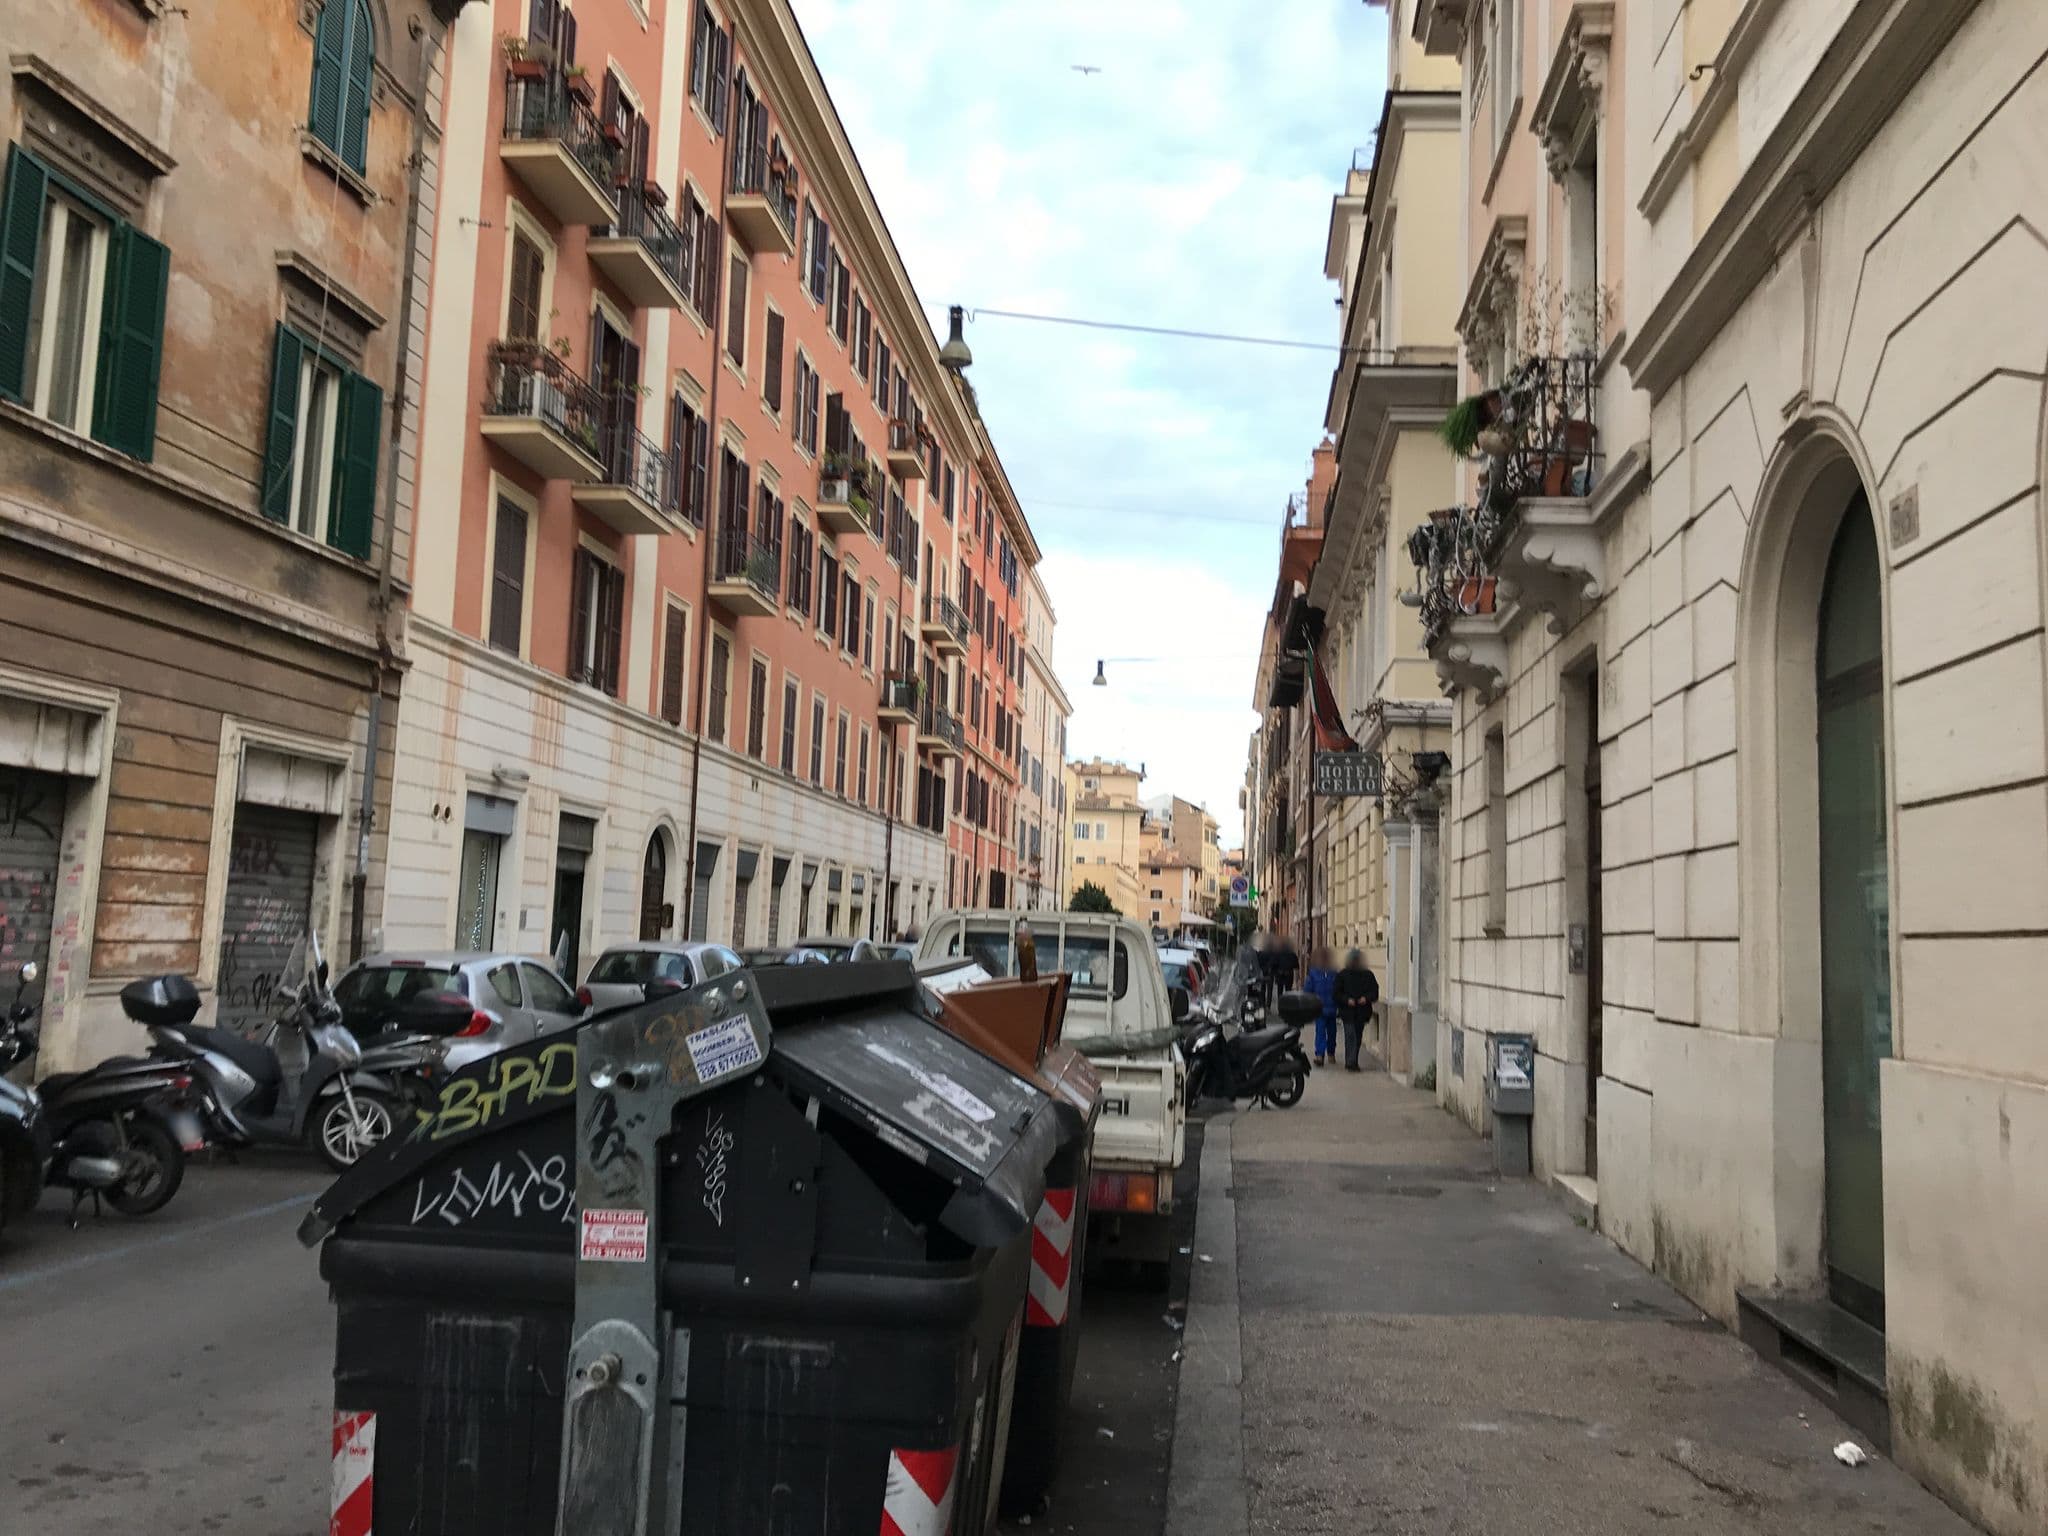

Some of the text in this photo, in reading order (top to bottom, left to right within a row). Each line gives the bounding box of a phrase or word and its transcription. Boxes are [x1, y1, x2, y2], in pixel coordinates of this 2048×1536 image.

[1320, 765, 1378, 779] HOTEL
[1321, 780, 1376, 793] CELIO
[689, 1014, 746, 1043] TRASLOCHI
[587, 1211, 644, 1222] TRASLOCHI
